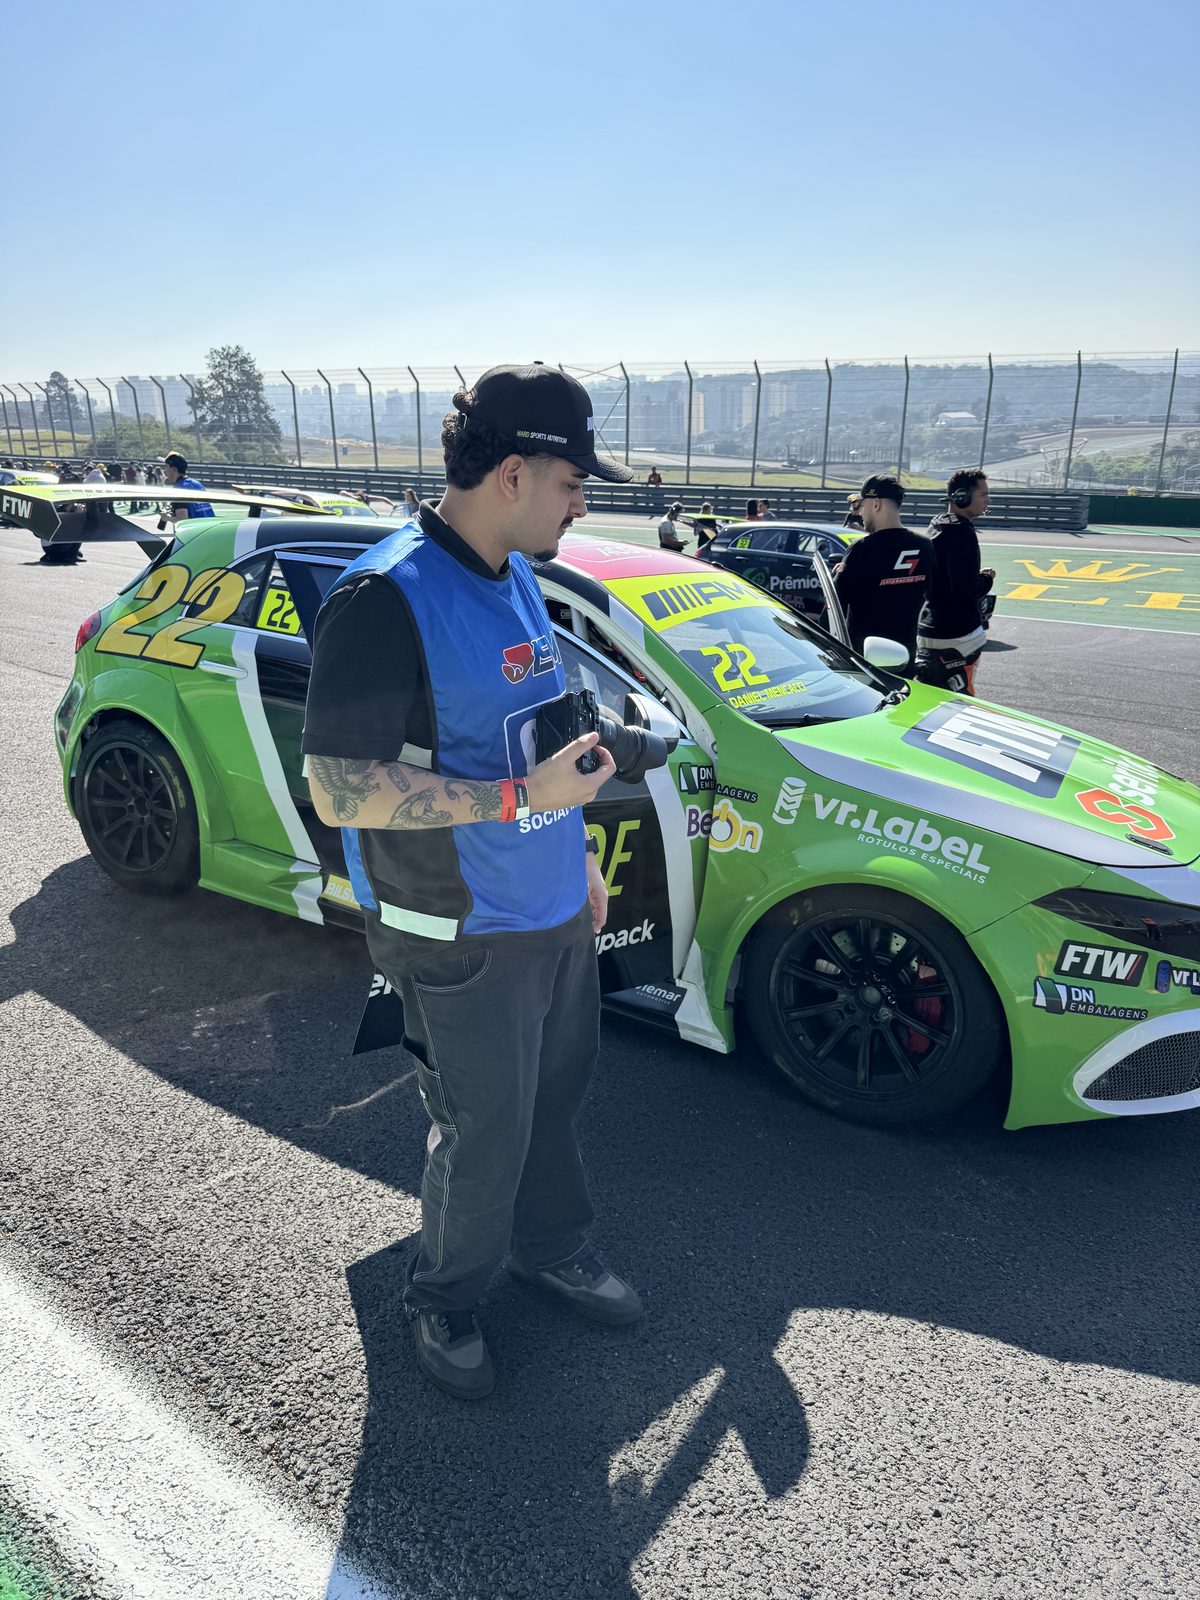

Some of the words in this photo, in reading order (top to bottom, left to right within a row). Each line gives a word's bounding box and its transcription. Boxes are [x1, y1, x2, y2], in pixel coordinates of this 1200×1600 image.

[529, 431, 547, 440] SPORTS
[547, 434, 568, 444] NUTRITION
[2, 495, 32, 519] FTW
[94, 563, 246, 670] 22
[266, 593, 295, 630] 22
[700, 643, 770, 692] 22
[728, 690, 767, 709] DANIEL
[700, 767, 713, 780] DN
[857, 833, 917, 856] ROTULOS
[920, 853, 987, 884] ESPECIAIS
[1061, 944, 1138, 980] FTW
[1071, 987, 1094, 1003] DN
[1070, 1002, 1147, 1019] EMBALAGENS
